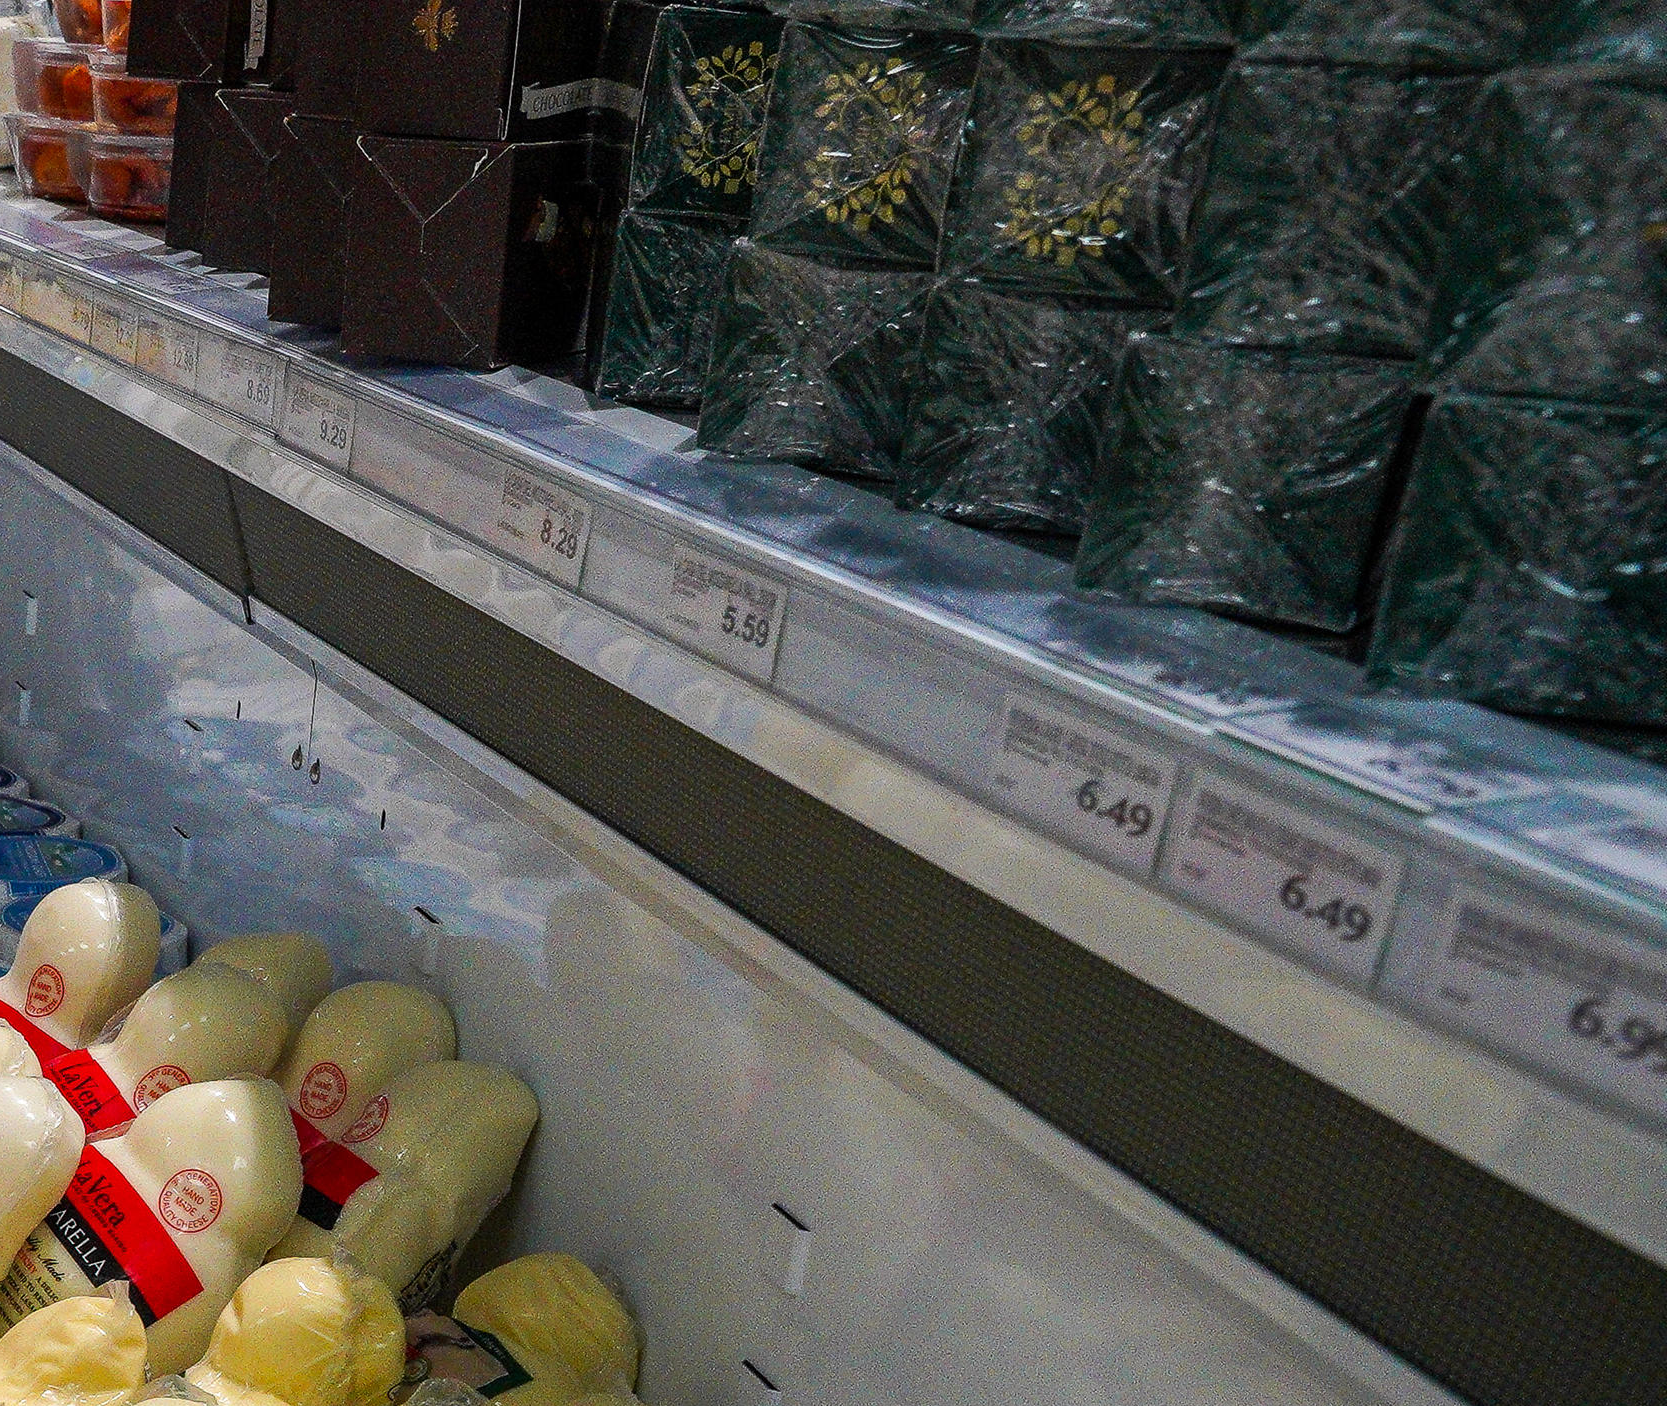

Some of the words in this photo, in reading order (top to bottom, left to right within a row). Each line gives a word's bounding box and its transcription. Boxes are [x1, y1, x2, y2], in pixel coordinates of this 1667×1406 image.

[319, 419, 347, 450] 9.29
[540, 519, 578, 559] 8.29
[721, 602, 771, 648] 5.59
[1076, 779, 1155, 838] 6.49
[1279, 870, 1375, 943] 6.49
[58, 1058, 107, 1118] LaVera
[73, 1160, 129, 1230] LaVera
[182, 1186, 204, 1205] HAND
[53, 1208, 107, 1277] ARELLA
